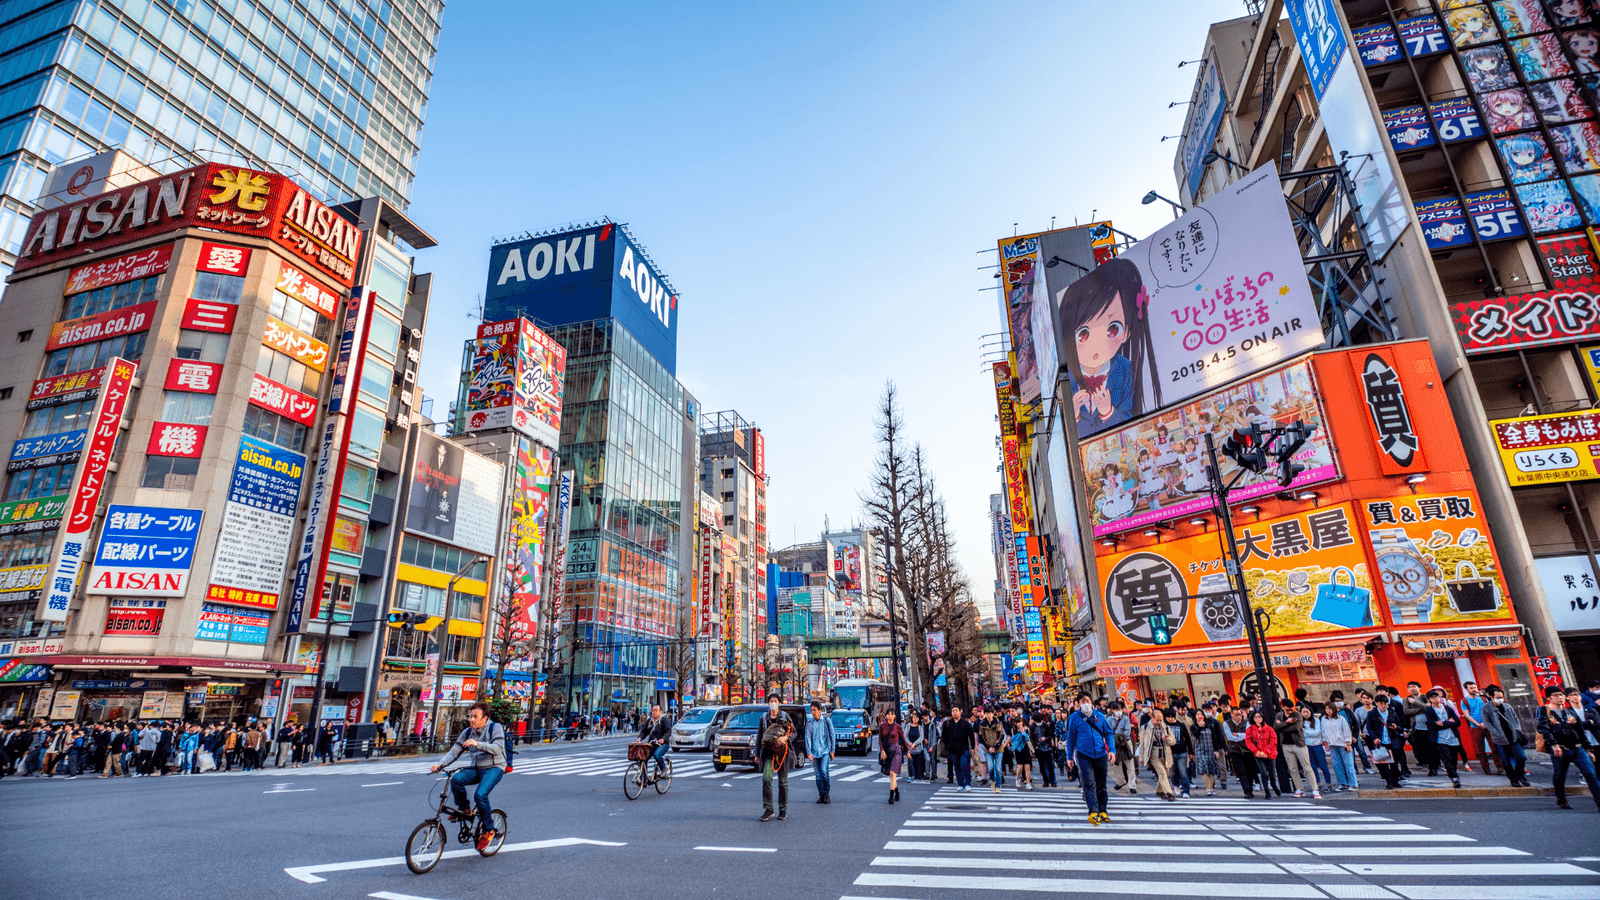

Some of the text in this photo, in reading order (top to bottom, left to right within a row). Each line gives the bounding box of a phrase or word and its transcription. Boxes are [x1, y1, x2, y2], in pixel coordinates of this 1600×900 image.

[1406, 32, 1445, 56] 7F
[1439, 116, 1480, 140] 6F
[209, 169, 271, 211] 光
[1240, 173, 1268, 192] KADOKAWA
[21, 172, 194, 257] AISAN
[197, 206, 270, 228] ネットワーク
[285, 189, 359, 262] AISAN
[1475, 211, 1518, 237] 5F
[1188, 220, 1206, 254] 友達に
[496, 233, 596, 286] AOKI
[1175, 230, 1192, 273] なりたい
[1551, 264, 1593, 277] Stars
[277, 267, 336, 314] 光通信
[620, 245, 669, 329] AOKI
[1171, 271, 1274, 325] ひとりぼっちの
[59, 311, 146, 345] aisan.co.jp
[483, 322, 515, 337] 免税店
[1471, 293, 1600, 343] メイド
[159, 247, 242, 455] 愛 三 電 機
[264, 322, 327, 366] ネットワーク
[1171, 345, 1236, 381] 2019.4.5
[1241, 336, 1267, 351] ON
[1271, 317, 1302, 341] AIR
[331, 317, 356, 401] 愛三電機
[34, 381, 51, 395] 3F
[250, 377, 315, 418] 配線パーツ
[14, 432, 86, 457] 2F ネットワーク
[1504, 419, 1600, 445] 全身もみほ
[241, 449, 301, 478] aisan.co.jp
[1296, 449, 1316, 460] cafe
[1520, 452, 1573, 468] りらくる
[418, 461, 461, 486] Change!
[562, 474, 570, 509] AKKY
[110, 512, 196, 532] 各種ケーブル
[1003, 516, 1013, 541] AKKY
[1237, 508, 1354, 566] 大黒屋
[101, 542, 189, 562] 配線パーツ
[48, 541, 82, 611] 愛三電機
[93, 572, 183, 590] AISAN
[1030, 555, 1042, 586] 吉野家
[1564, 573, 1593, 589] 喫茶
[210, 587, 226, 598] 各社
[228, 590, 243, 601] 特約
[245, 592, 260, 603] 在庫
[289, 562, 308, 627] AISAN
[1012, 590, 1021, 615] Shop
[1114, 560, 1184, 636] 質
[18, 645, 41, 654] aisan.
[1427, 635, 1519, 649] 1階にて高価買取中
[1316, 649, 1364, 664] 無料査定
[1536, 658, 1552, 669] 4F
